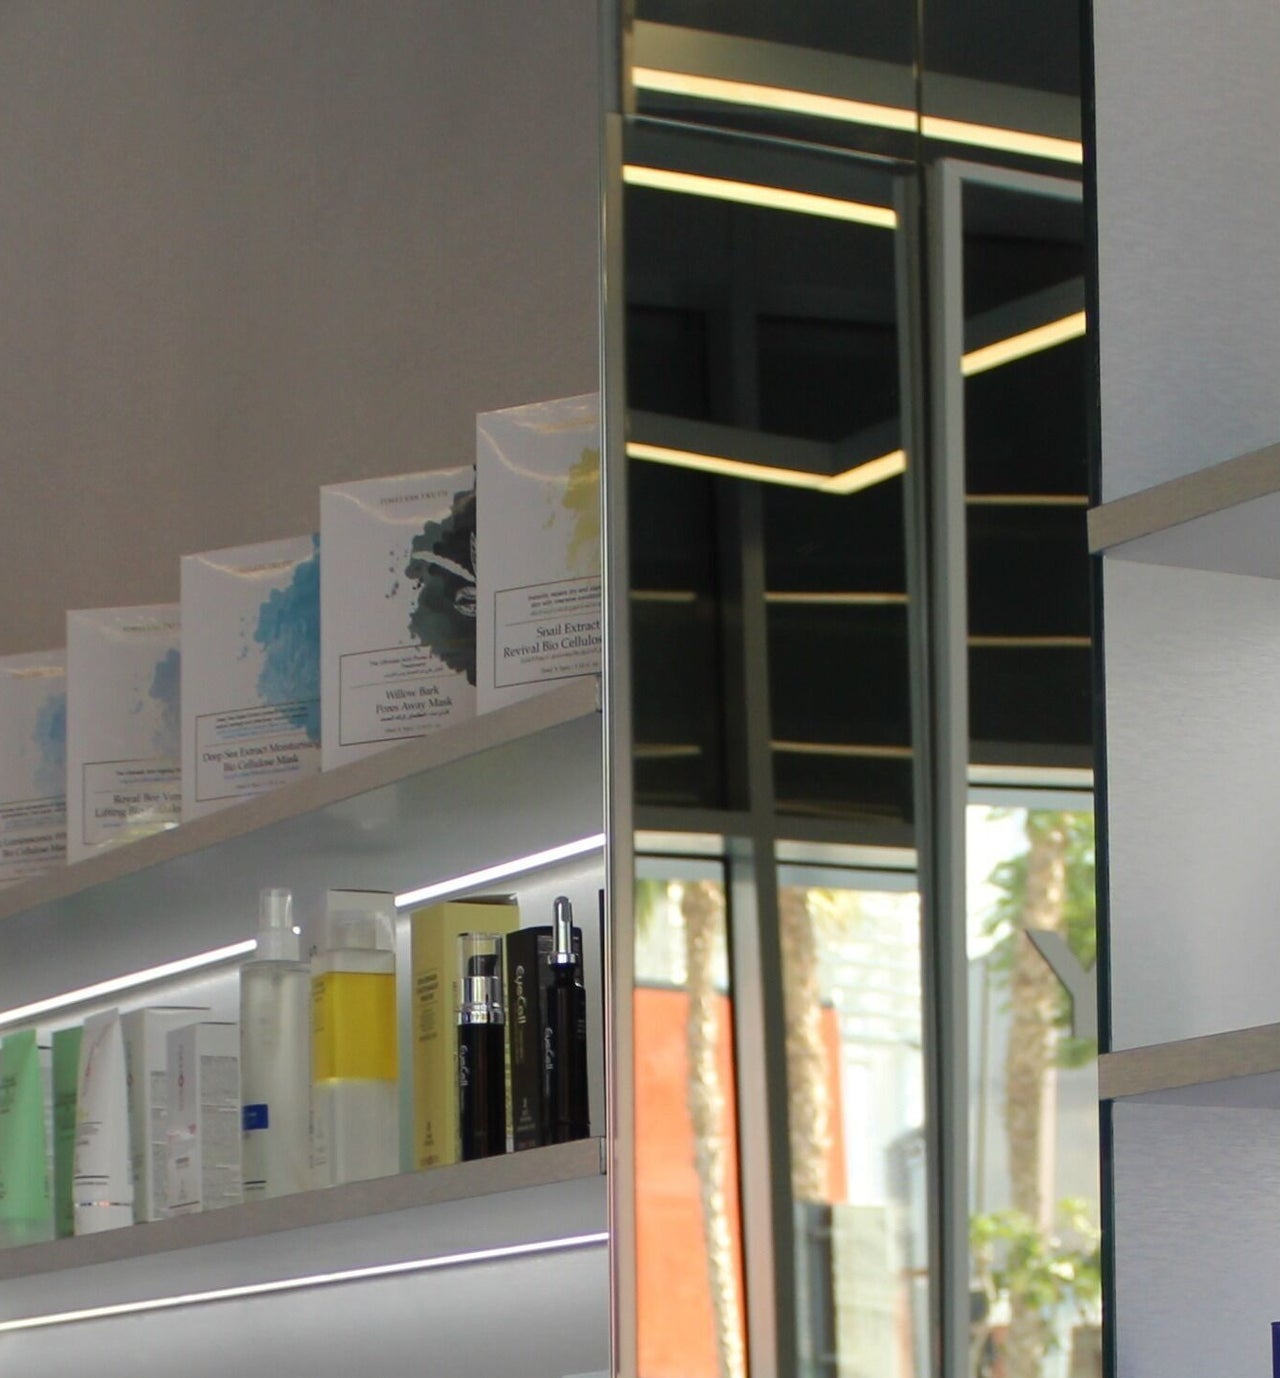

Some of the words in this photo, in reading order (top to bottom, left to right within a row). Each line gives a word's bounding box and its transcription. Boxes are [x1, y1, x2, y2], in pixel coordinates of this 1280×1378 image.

[536, 623, 561, 637] Snail
[565, 621, 600, 633] Extract
[504, 643, 539, 658] Revival
[543, 641, 558, 651] Bio
